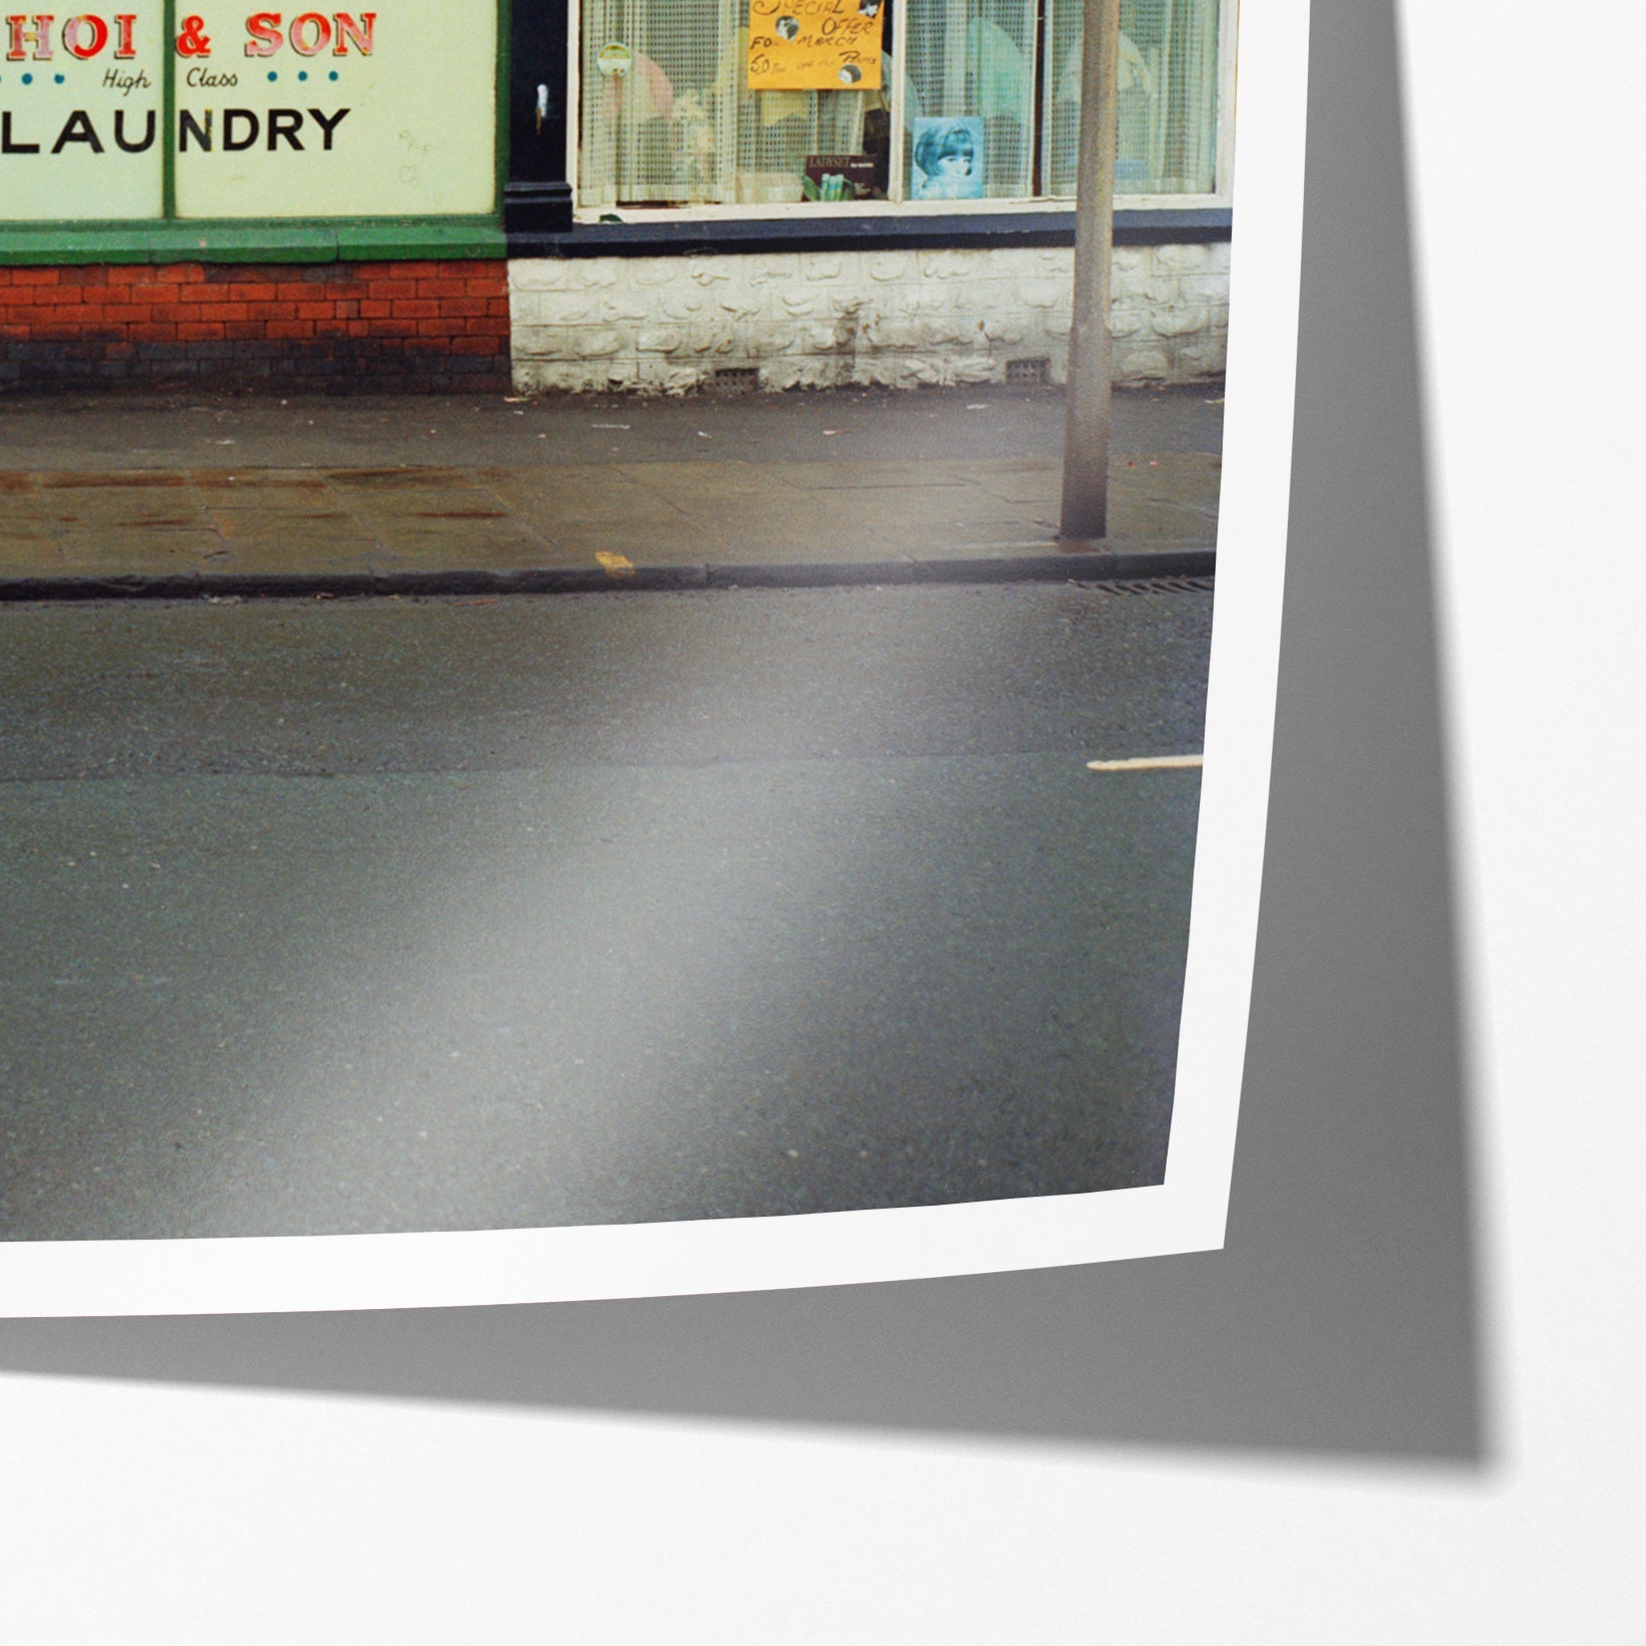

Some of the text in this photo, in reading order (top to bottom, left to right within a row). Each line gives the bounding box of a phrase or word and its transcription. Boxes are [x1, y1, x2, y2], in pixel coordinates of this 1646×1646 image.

[175, 15, 211, 58] &
[245, 12, 377, 57] SON
[102, 67, 238, 96] High Class
[1, 108, 351, 154] LAUNDRY
